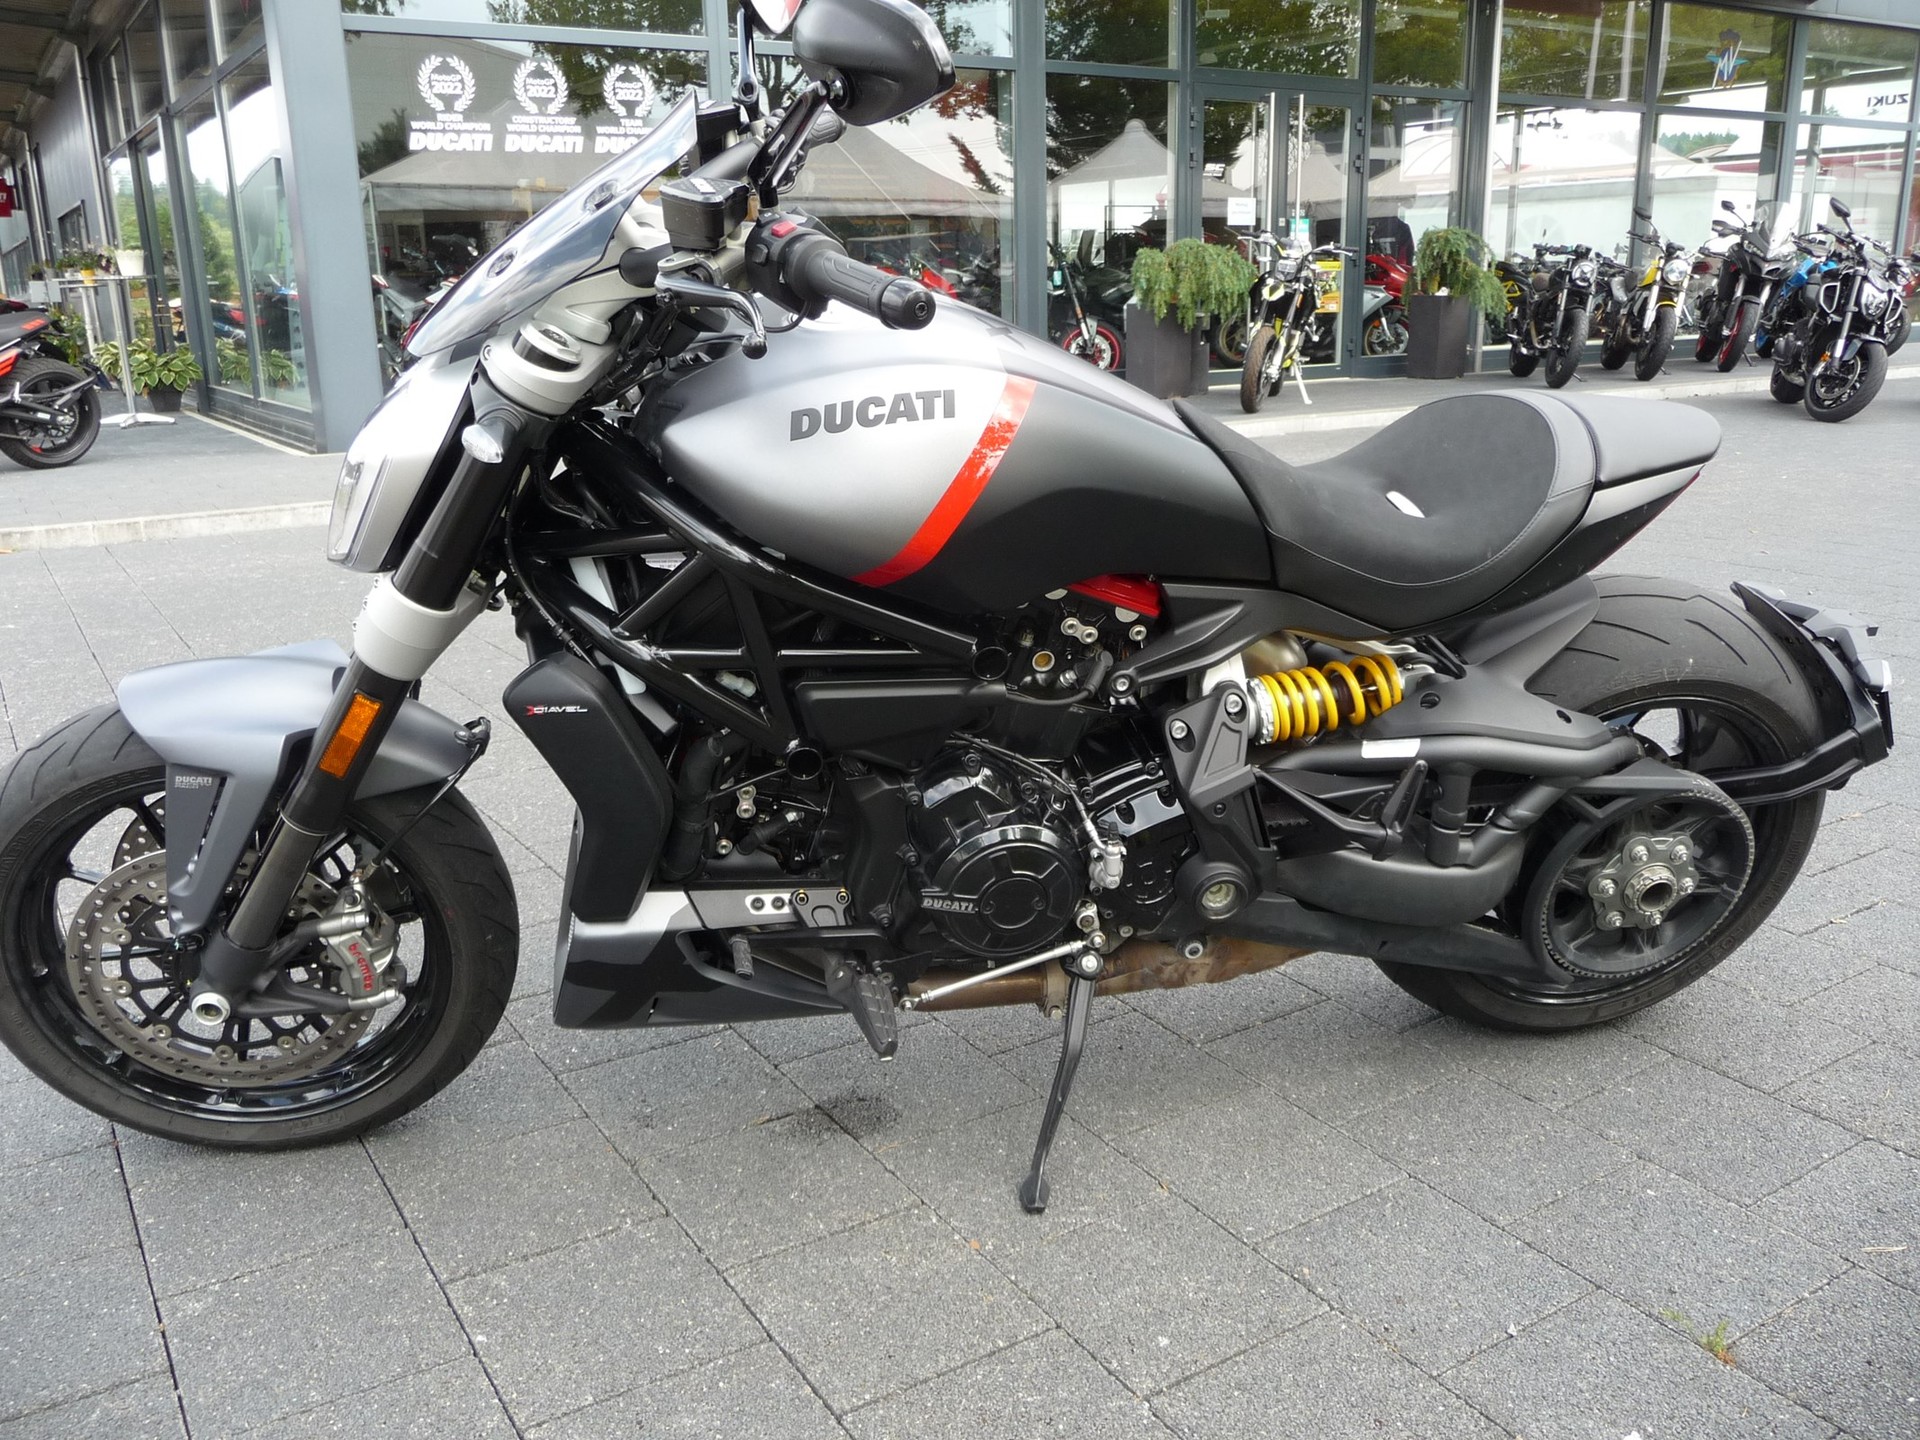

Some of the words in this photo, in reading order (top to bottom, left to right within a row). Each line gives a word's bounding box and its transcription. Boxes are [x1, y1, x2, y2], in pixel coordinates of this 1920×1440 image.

[430, 73, 462, 82] MotoGP
[525, 77, 556, 86] MotoGP
[431, 81, 463, 94] 2022
[615, 81, 643, 89] MotoGP
[526, 85, 556, 98] 2022
[615, 89, 644, 101] 2022
[410, 120, 444, 130] WORLD
[444, 121, 491, 132] CHAMPION
[505, 123, 538, 133] WORLD
[538, 124, 582, 134] CHAMPION
[619, 118, 644, 127] TEAM
[595, 126, 625, 135] WORLD
[409, 131, 494, 152] DUCATI
[504, 134, 584, 154] DUCATI
[594, 136, 639, 154] DUC
[790, 389, 956, 442] DUCATI
[175, 775, 213, 784] DUCATI
[922, 897, 974, 912] DUCATI
[348, 942, 376, 992] brembo
